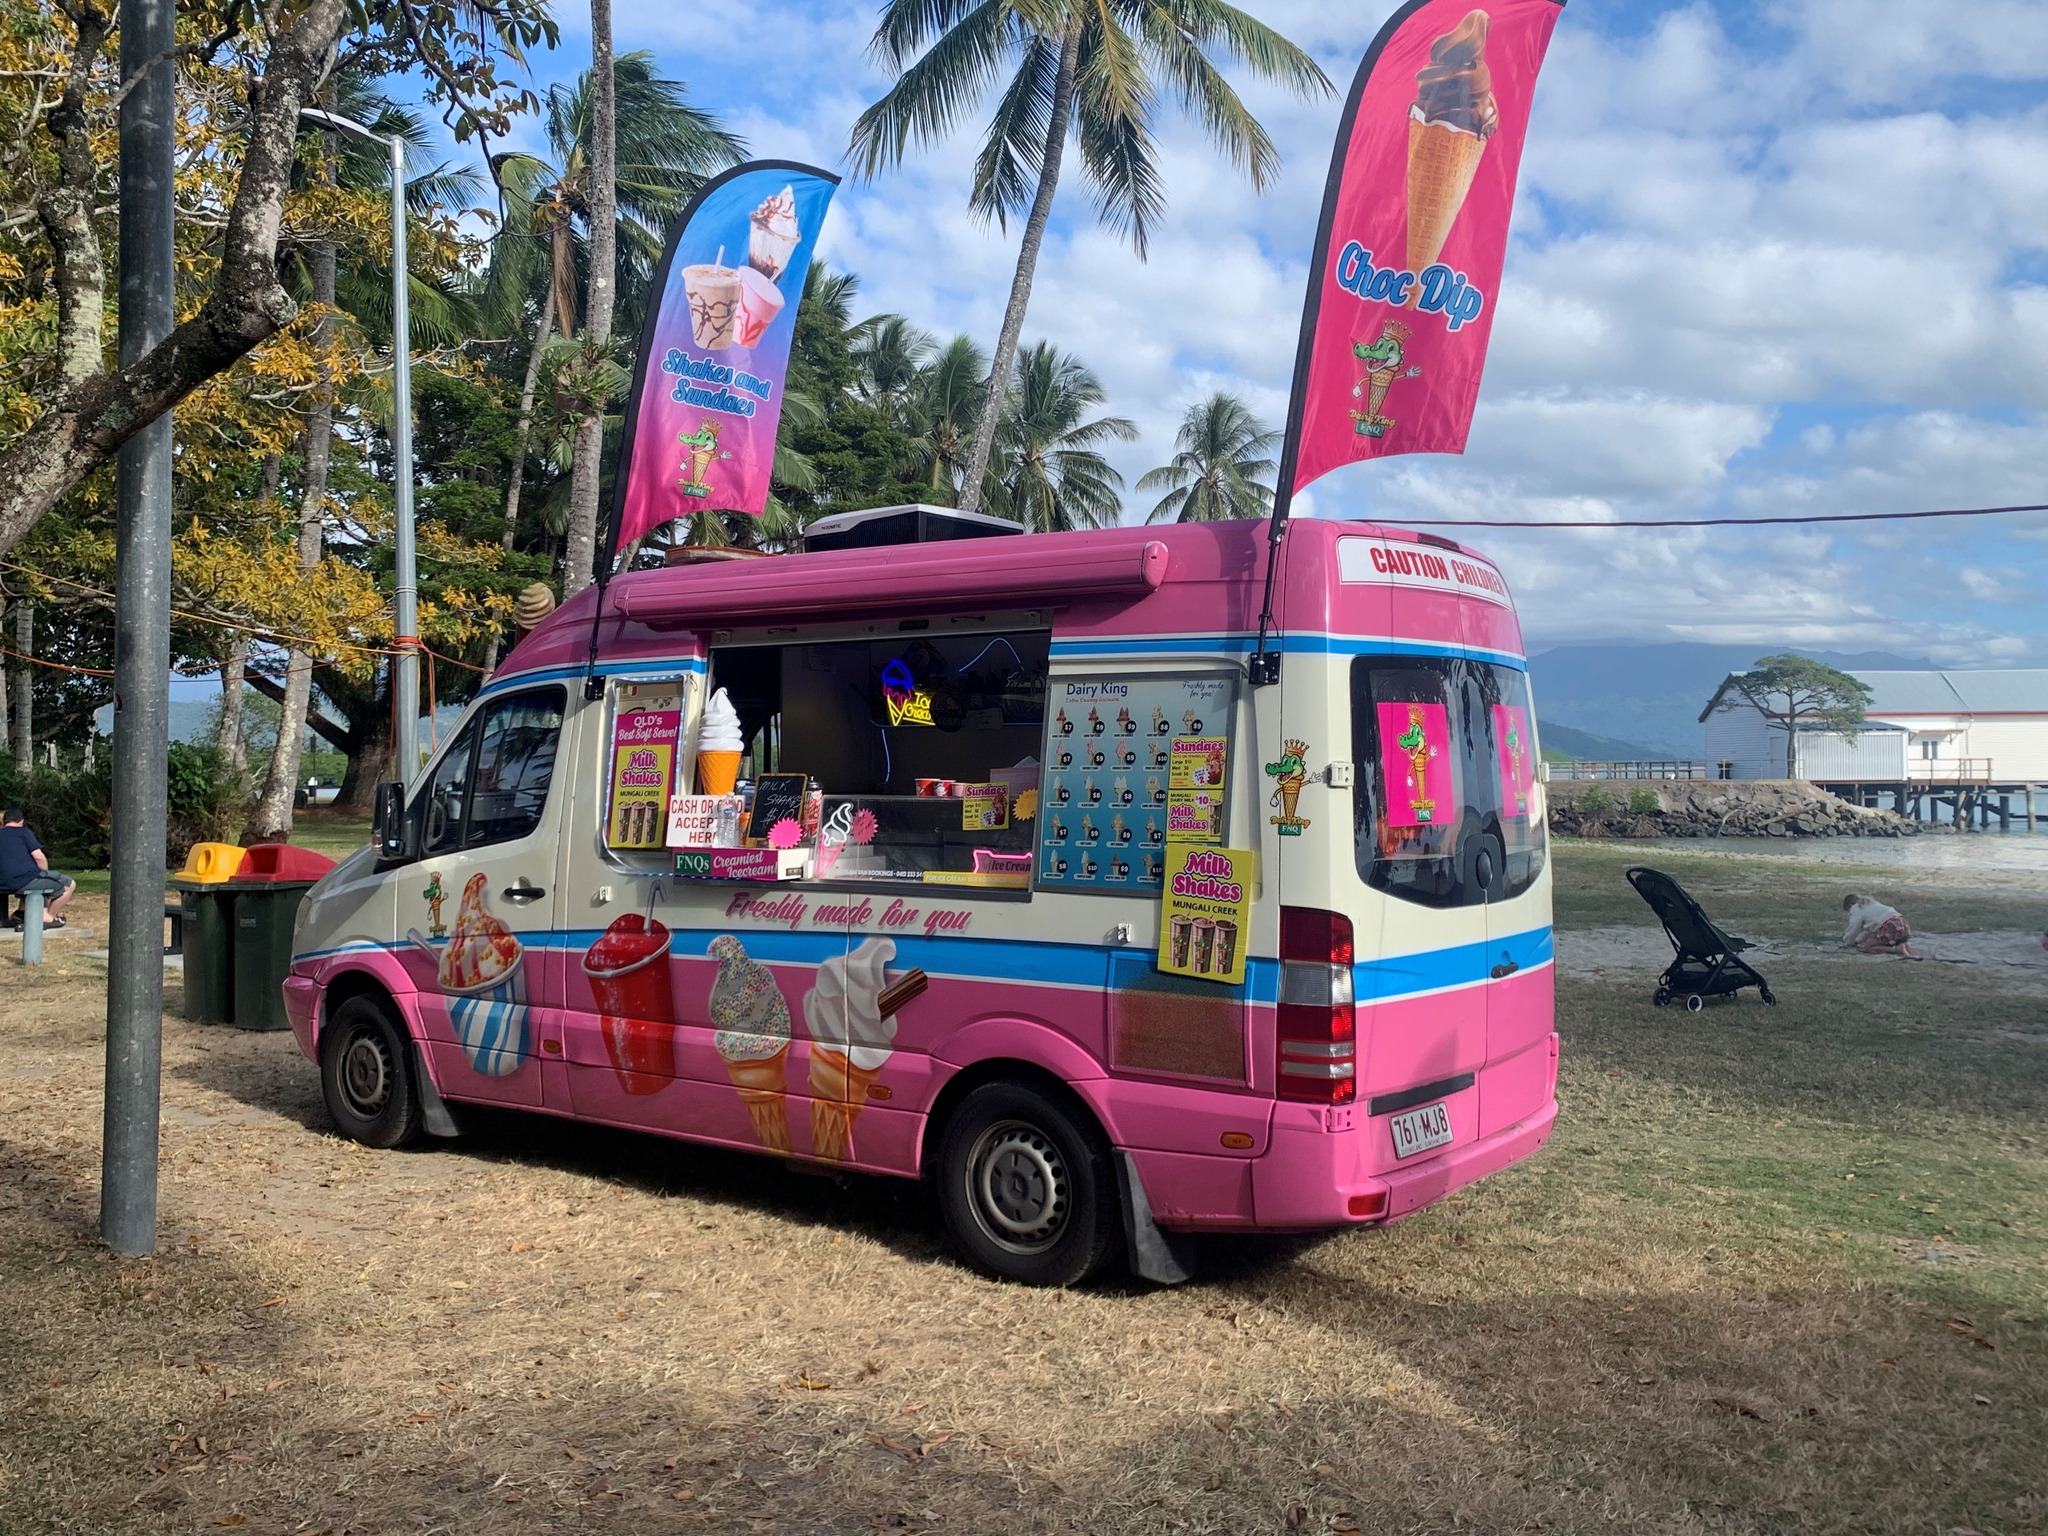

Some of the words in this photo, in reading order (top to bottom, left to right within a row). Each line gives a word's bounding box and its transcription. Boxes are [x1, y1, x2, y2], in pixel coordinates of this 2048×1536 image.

[1337, 240, 1415, 305] Choc
[1419, 264, 1483, 331] Dip
[661, 348, 735, 385] Shakes
[734, 372, 772, 401] and
[671, 378, 756, 417] Sundaes
[1349, 408, 1374, 425] Dairy
[1374, 414, 1397, 430] King
[1360, 423, 1380, 435] FNQ
[687, 487, 704, 496] FNQ
[1369, 547, 1450, 581] CAUTION
[1451, 559, 1506, 597] CHILDREN
[1066, 682, 1098, 698] Dairy
[1101, 682, 1128, 697] King
[633, 715, 663, 728] QLD's
[618, 729, 636, 740] Best
[635, 727, 653, 742] Soft
[652, 726, 678, 739] Serve!
[1172, 739, 1225, 754] Sundaes
[628, 749, 657, 769] Milk
[619, 768, 663, 787] Shakes
[965, 784, 1008, 798] Sundaes
[671, 799, 699, 814] CASH
[701, 799, 714, 814] OR
[1169, 803, 1196, 818] Milk
[1418, 809, 1431, 820] FNQ
[1168, 818, 1209, 832] Shakes
[1282, 825, 1299, 835] FNQ
[676, 855, 710, 871] FNQs
[713, 851, 764, 867] Creamiest
[991, 860, 1005, 871] Ice
[1184, 850, 1233, 879] Milk
[726, 860, 778, 879] Icecream!
[1172, 872, 1243, 903] Shakes
[724, 891, 809, 929] Freshly
[812, 897, 874, 926] made
[877, 898, 920, 928] for
[923, 910, 972, 937] you
[1172, 900, 1211, 912] MUNGALI
[1212, 905, 1238, 916] CREEK
